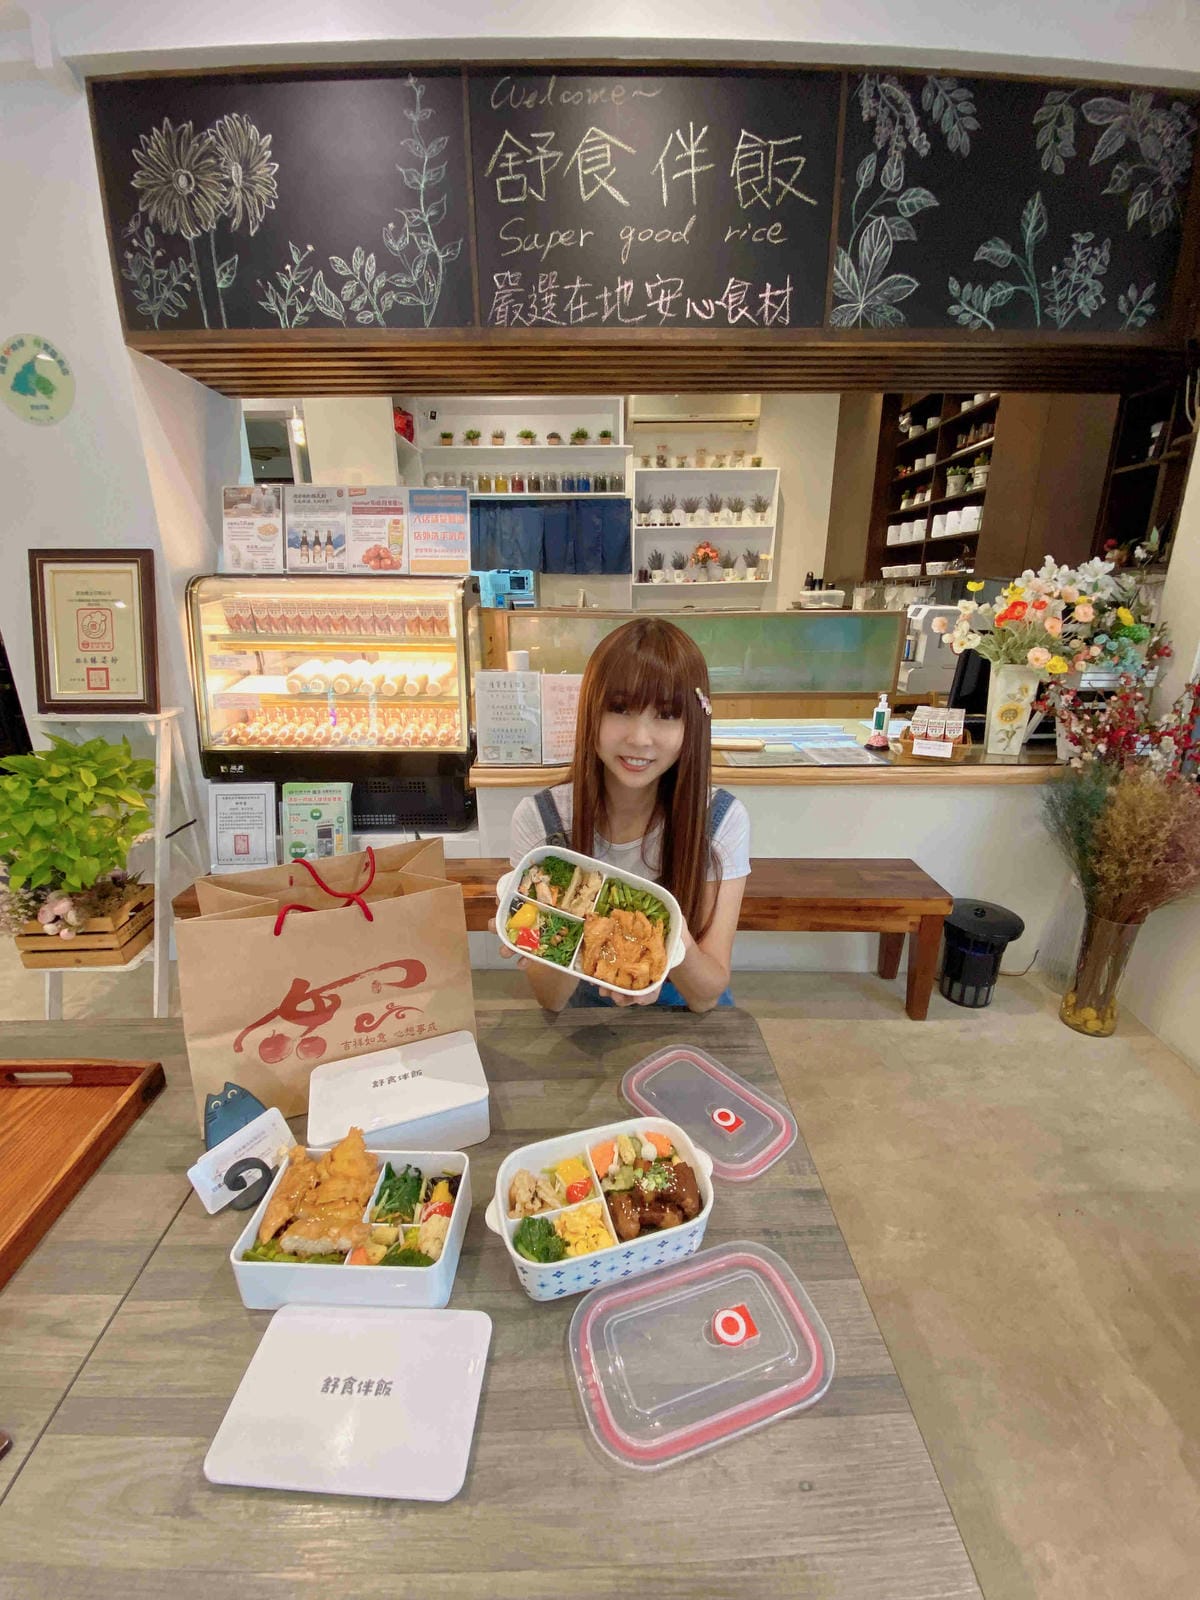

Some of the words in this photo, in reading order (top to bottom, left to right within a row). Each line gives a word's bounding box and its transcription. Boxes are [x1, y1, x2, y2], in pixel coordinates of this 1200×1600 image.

[484, 121, 818, 210] 舒食伴飯
[499, 217, 595, 262] Super
[619, 214, 697, 265] good
[724, 222, 788, 244] rice
[487, 271, 794, 326] 嚴選在地安心食材
[340, 1032, 387, 1051] 吉祥如意
[393, 1021, 438, 1038] 心想事成
[371, 1068, 423, 1089] 舒食伴飯
[320, 1375, 394, 1397] 舒食伴飯
